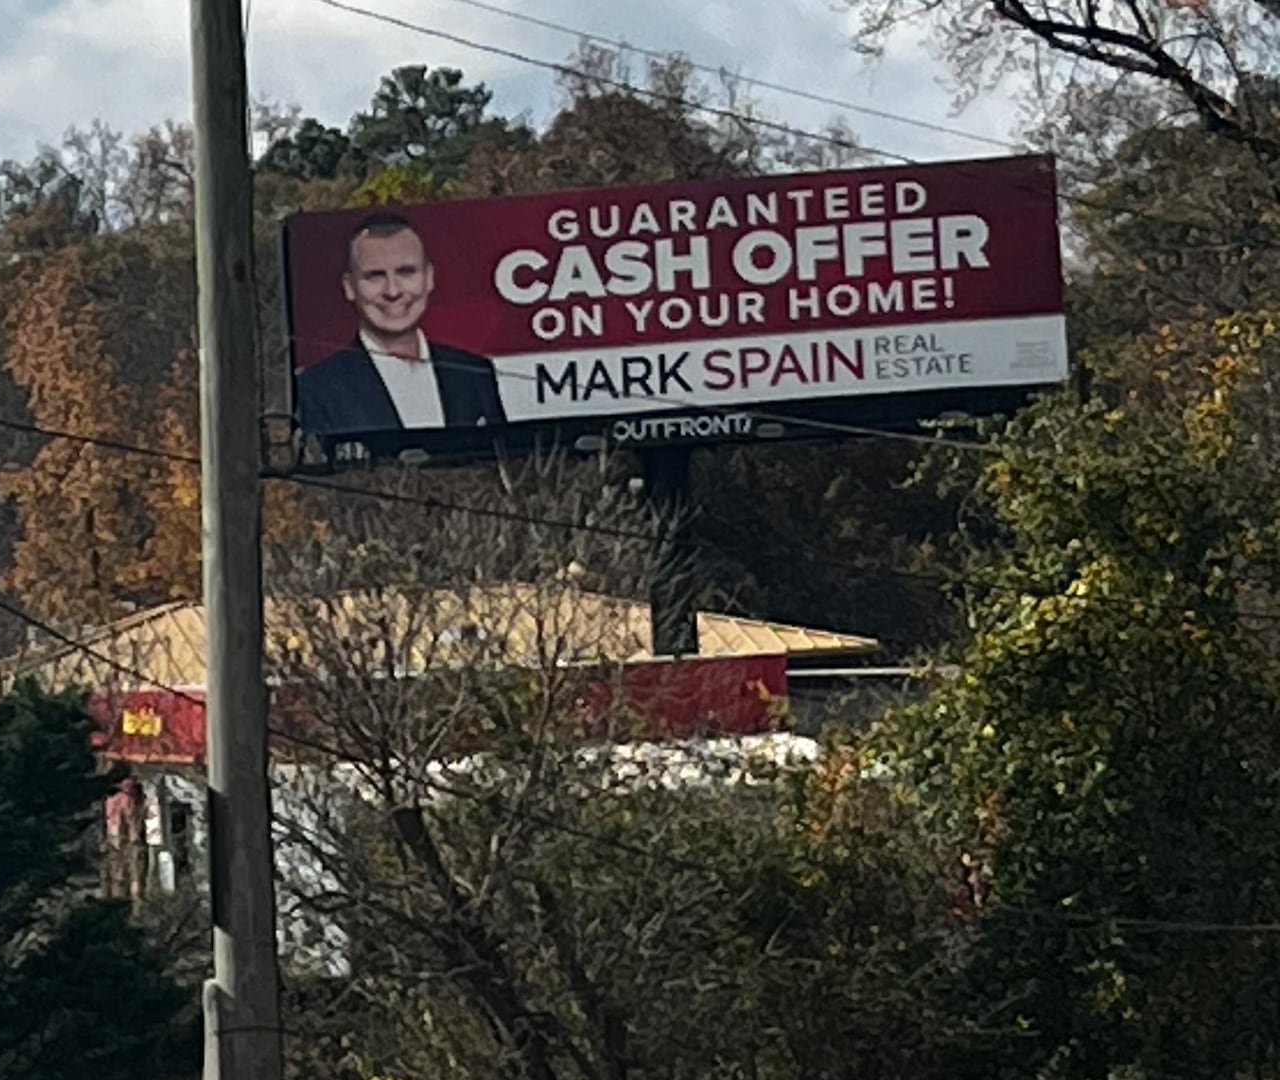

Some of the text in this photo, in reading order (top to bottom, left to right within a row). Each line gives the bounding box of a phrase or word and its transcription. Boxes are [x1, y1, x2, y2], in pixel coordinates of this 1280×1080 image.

[548, 181, 927, 240] GUARANTEED
[495, 215, 990, 303] CASH OFFER
[531, 277, 956, 341] ON YOUR HOME!
[537, 340, 864, 402] MARK SPAIN
[874, 334, 943, 354] REAL
[875, 353, 973, 379] ESTATE
